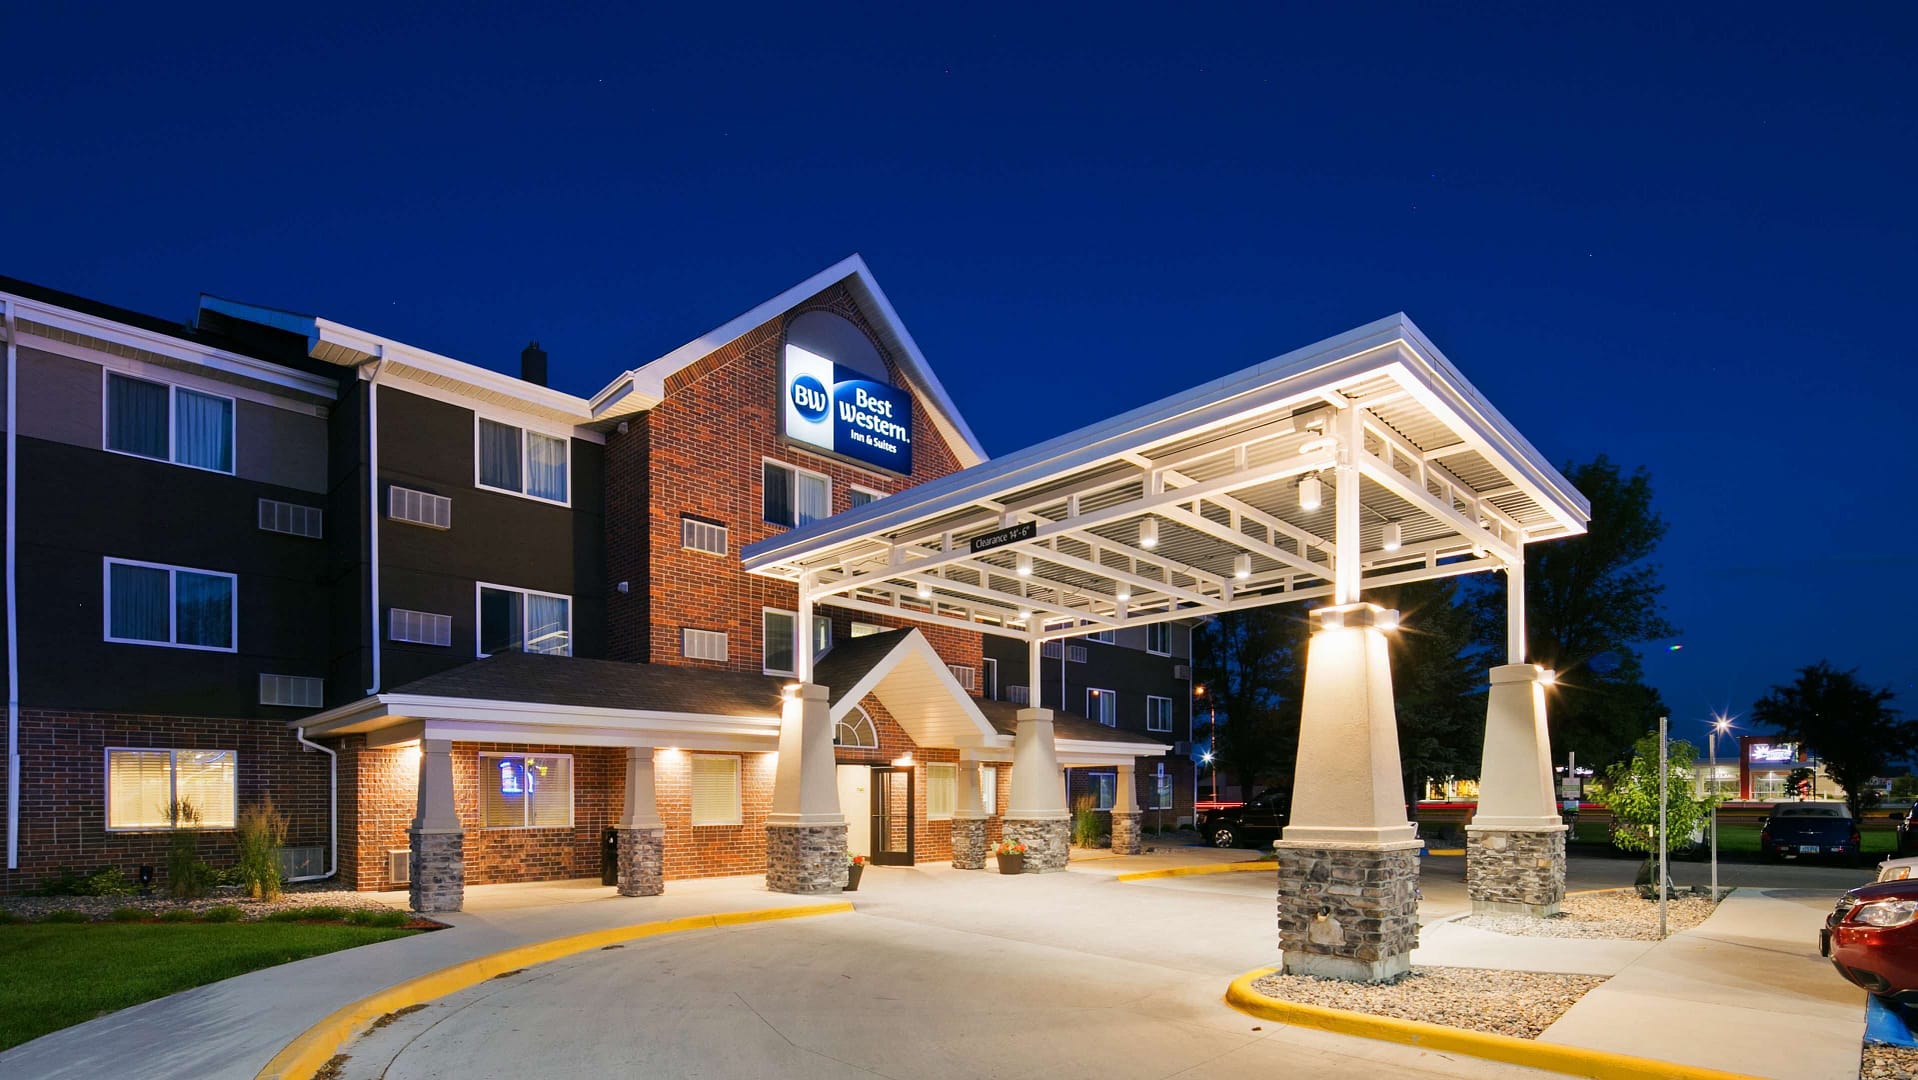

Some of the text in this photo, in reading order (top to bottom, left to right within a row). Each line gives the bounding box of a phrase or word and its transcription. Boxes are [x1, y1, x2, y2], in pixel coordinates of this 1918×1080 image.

[794, 384, 826, 412] BW
[855, 387, 893, 418] Best
[850, 429, 897, 454] Inn & Suites
[975, 533, 1008, 549] Clearance
